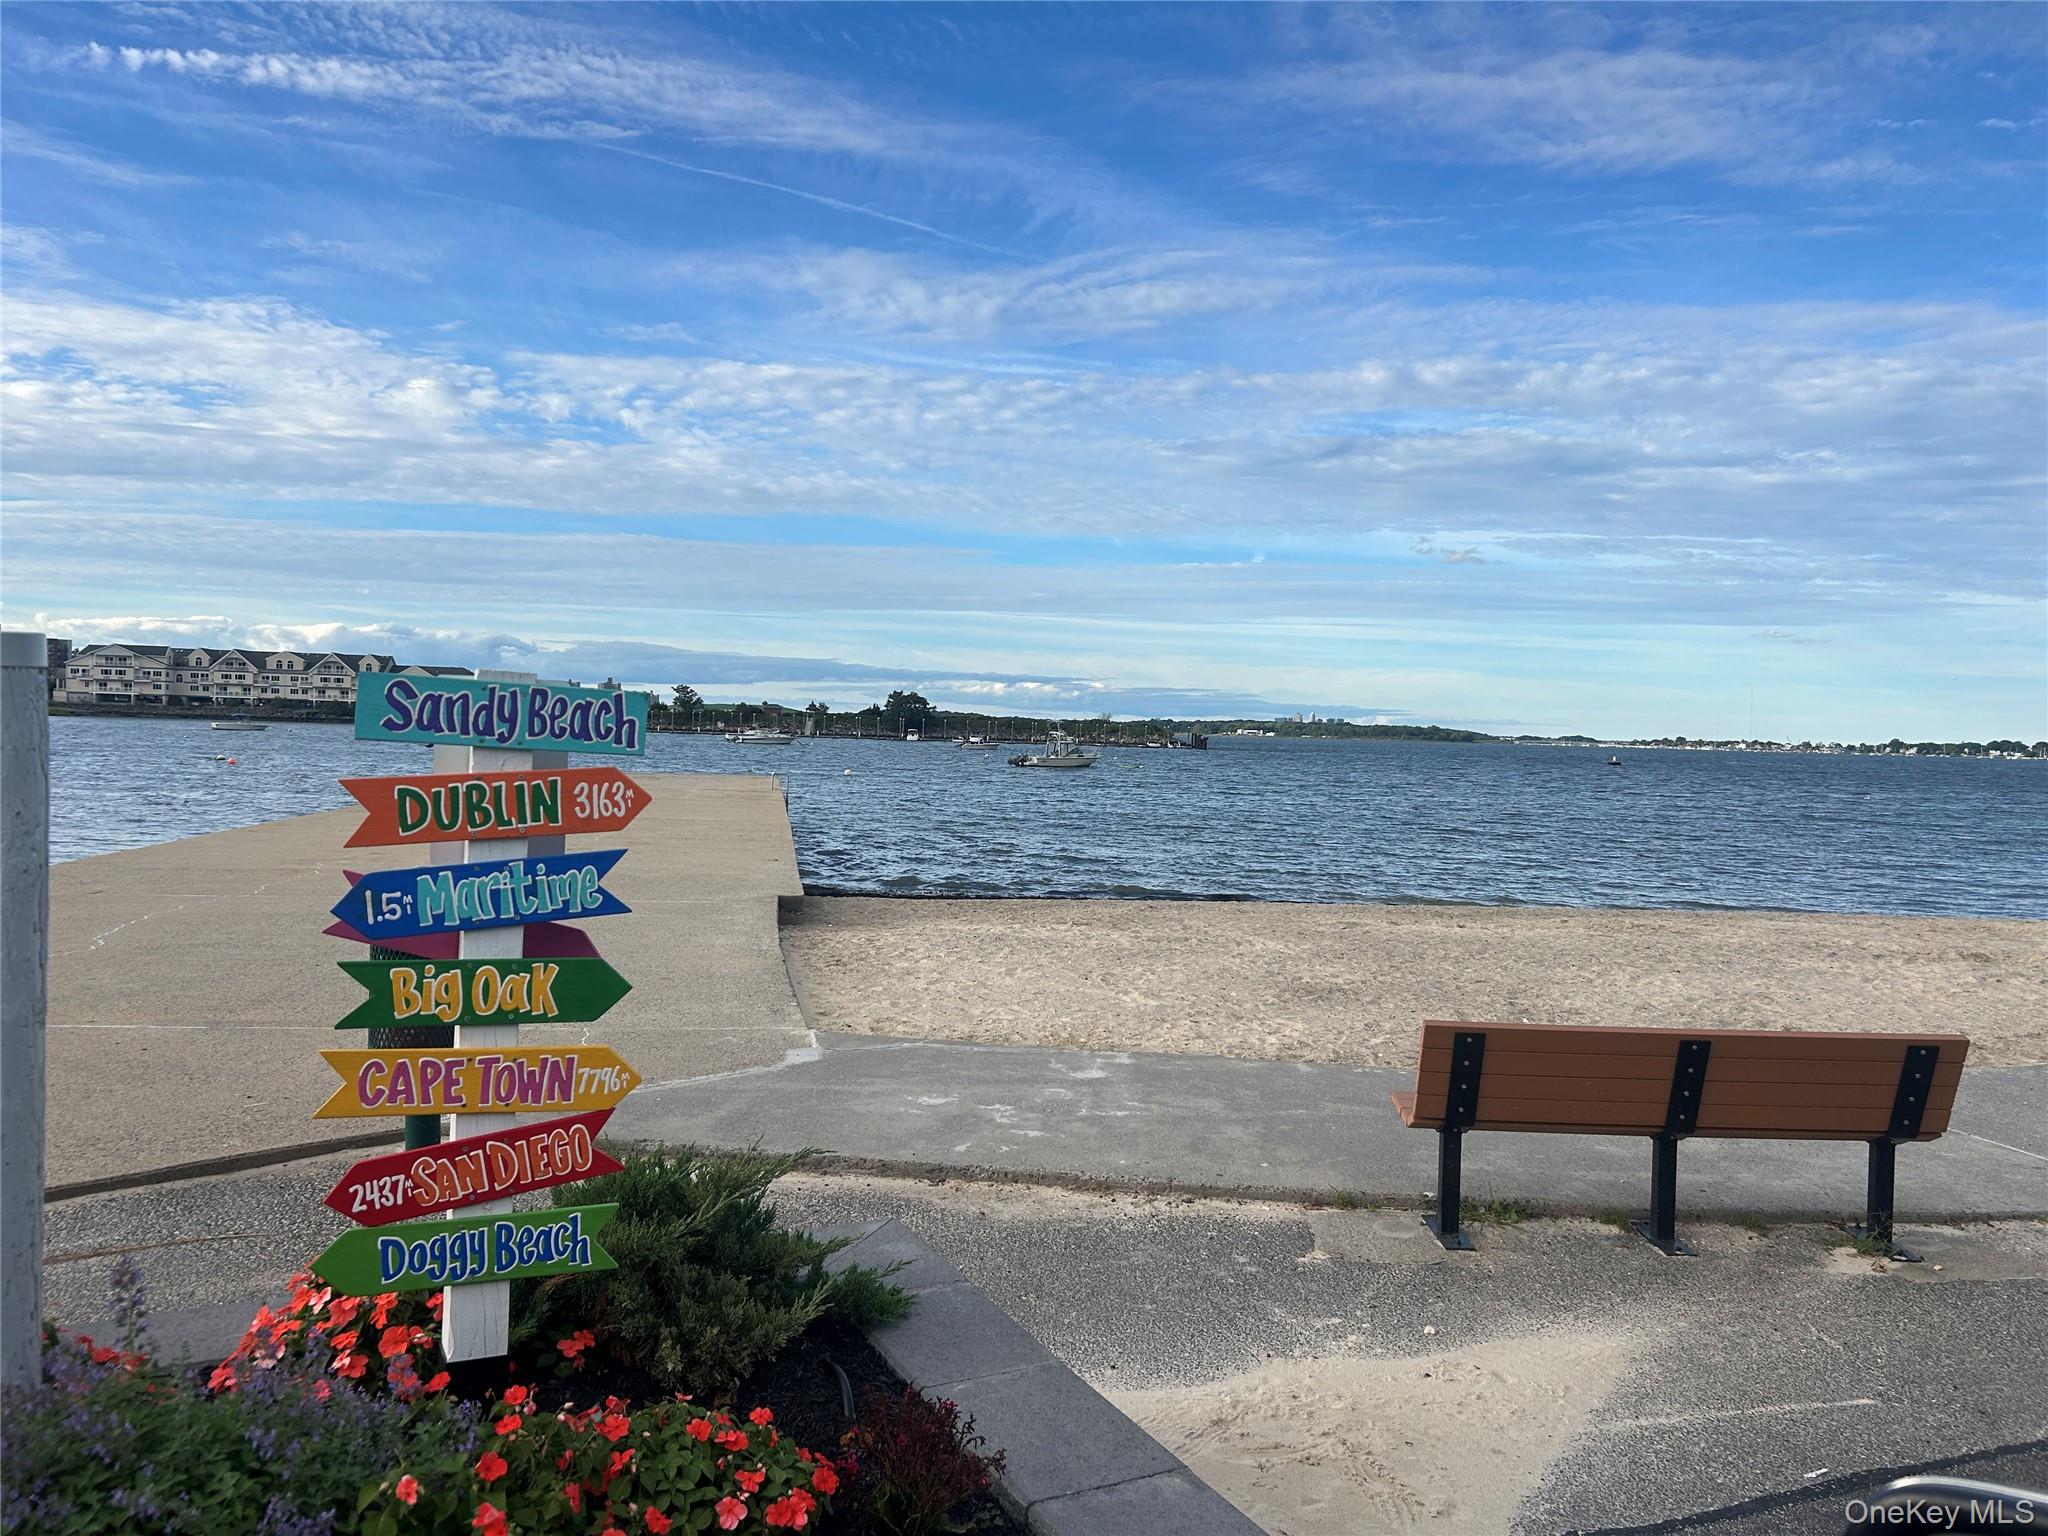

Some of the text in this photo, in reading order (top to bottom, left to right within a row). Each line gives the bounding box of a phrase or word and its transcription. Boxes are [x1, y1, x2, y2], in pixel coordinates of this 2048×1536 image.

[380, 679, 639, 750] Sandy Beach
[394, 777, 562, 836] DUBLIN
[416, 861, 603, 926] Maritime
[389, 964, 463, 1022] Big
[358, 1055, 466, 1108] CAPE
[473, 1055, 578, 1107] TOWN
[411, 1149, 488, 1207] SAN
[485, 1123, 593, 1191] DIEGO
[378, 1212, 593, 1285] Doggy Beach
